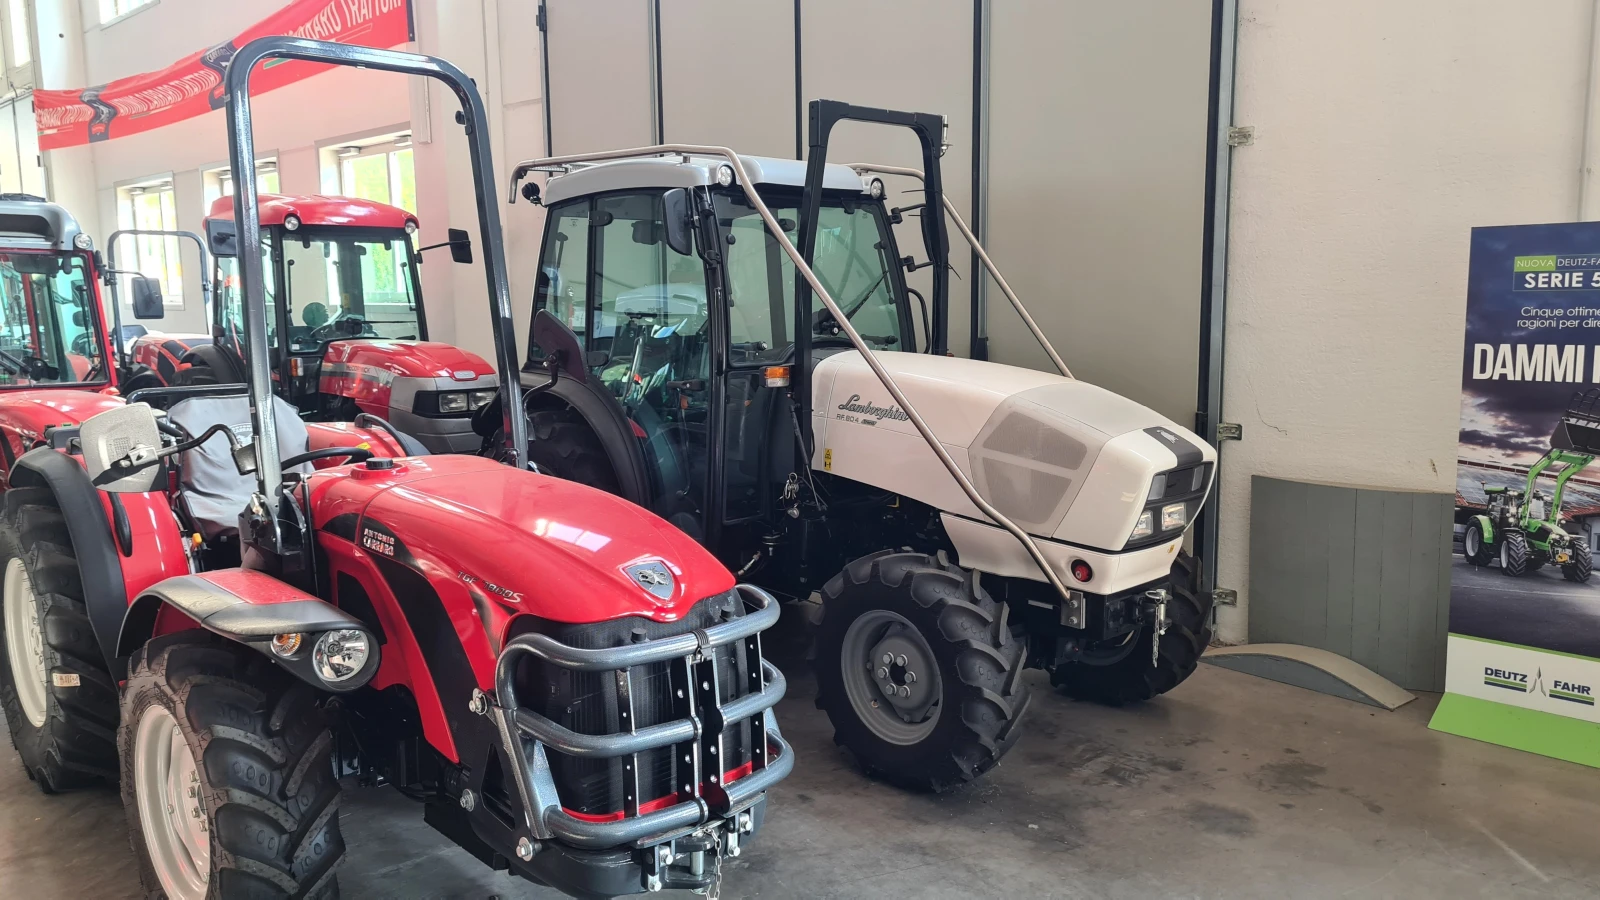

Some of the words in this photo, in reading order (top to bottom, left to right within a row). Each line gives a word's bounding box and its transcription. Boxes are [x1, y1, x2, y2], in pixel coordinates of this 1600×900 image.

[1516, 259, 1554, 268] NUOVA
[1524, 272, 1584, 289] SERIE
[1521, 306, 1564, 319] Cinque
[1516, 318, 1556, 330] ragioni
[1559, 319, 1580, 330] per
[1472, 343, 1585, 383] DAMMI
[363, 528, 395, 545] ANTONIO
[363, 536, 394, 557] CARRARO
[457, 571, 480, 584] TGF
[1484, 667, 1528, 683] DEUTZ
[1553, 680, 1591, 696] FAHR
